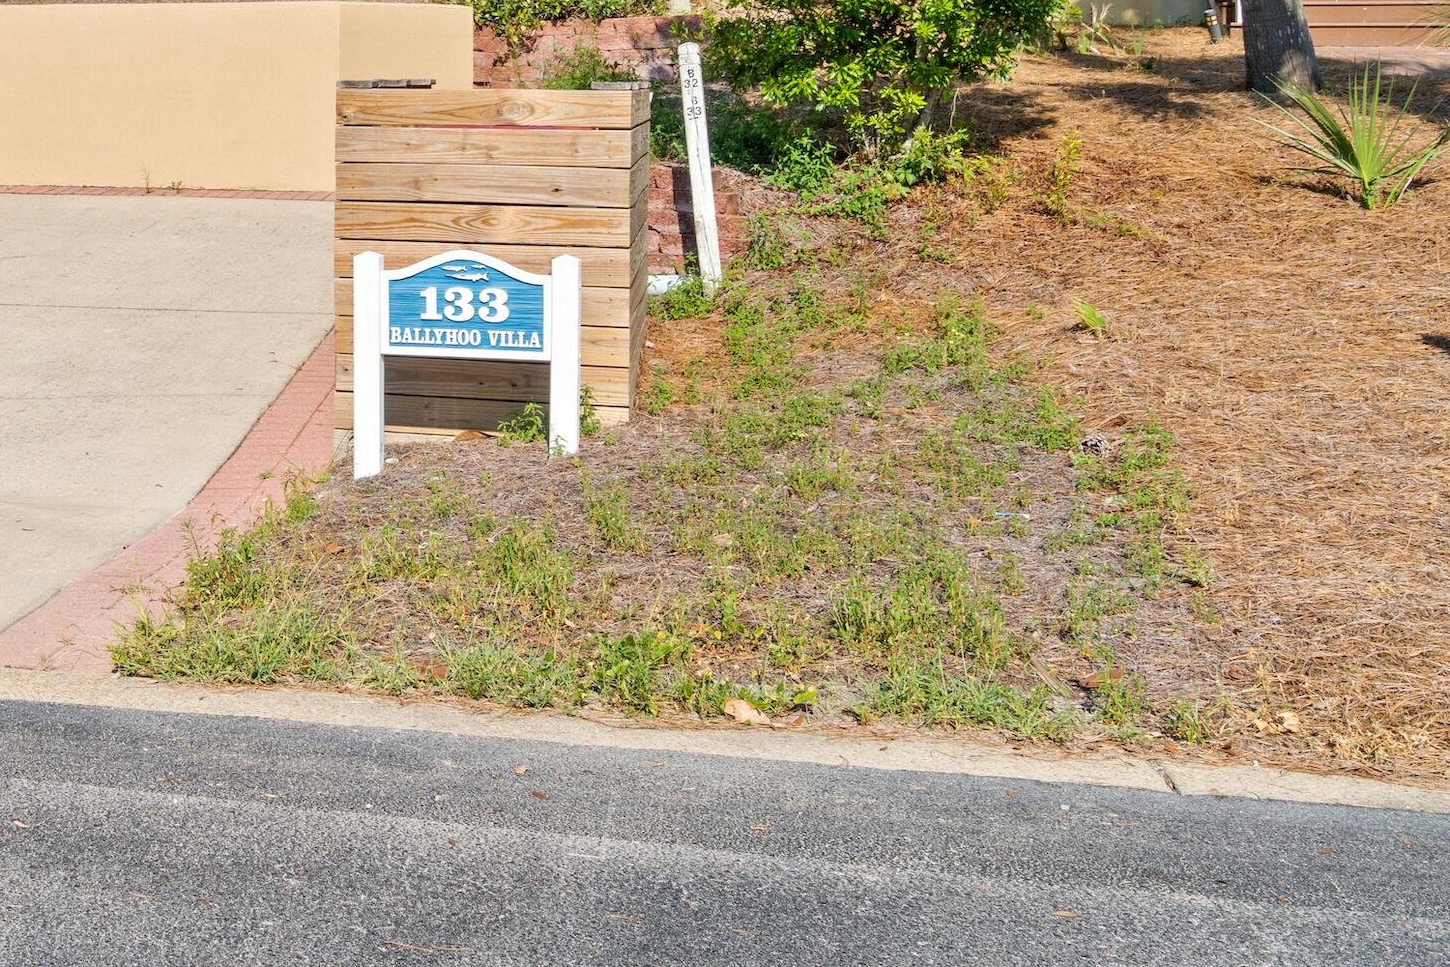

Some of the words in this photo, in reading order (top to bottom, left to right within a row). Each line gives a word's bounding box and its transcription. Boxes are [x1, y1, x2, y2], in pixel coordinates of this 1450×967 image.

[684, 79, 699, 89] 32
[686, 107, 702, 116] 33
[420, 286, 510, 323] 133
[390, 327, 481, 346] BALLYHOO
[487, 330, 543, 348] VILLA
